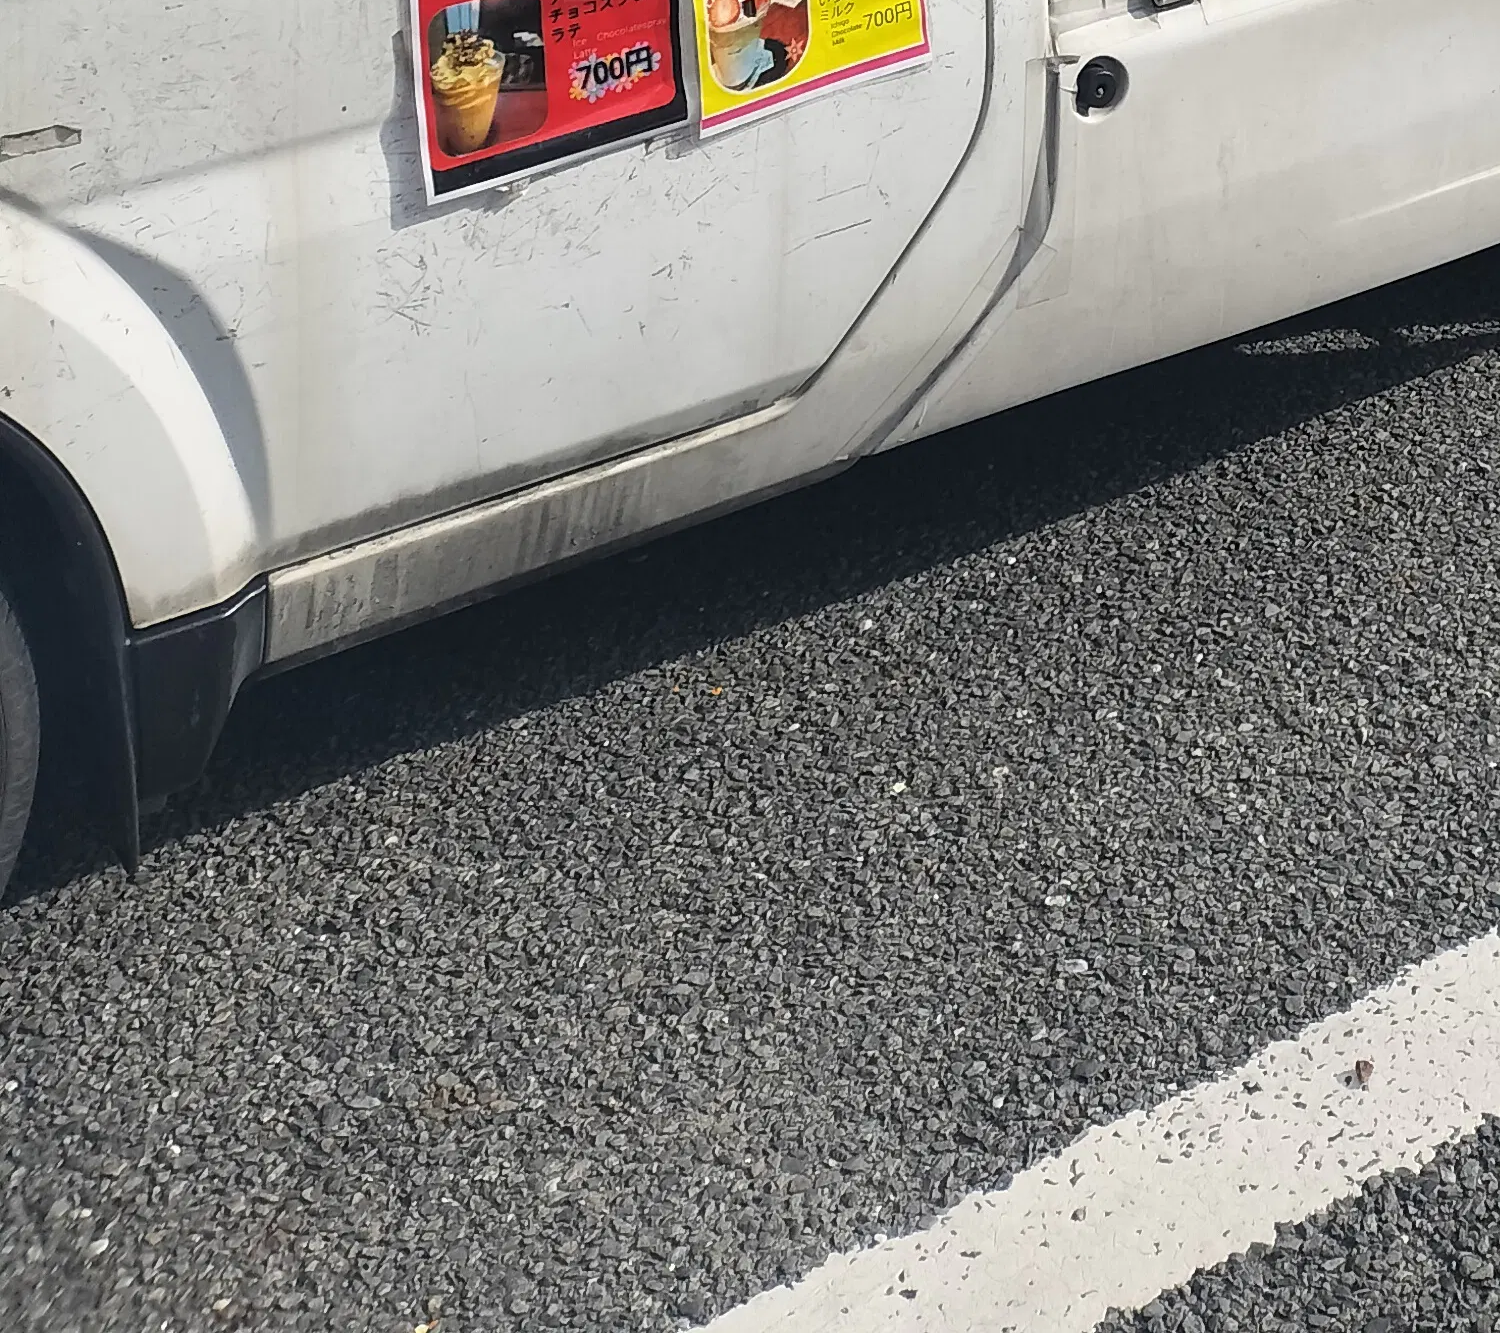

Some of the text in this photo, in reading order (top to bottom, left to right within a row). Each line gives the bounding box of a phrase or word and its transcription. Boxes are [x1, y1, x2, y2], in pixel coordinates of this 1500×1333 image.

[820, 2, 855, 21] ミルク
[863, 0, 912, 31] 700円
[551, 24, 581, 44] ラテ
[576, 45, 651, 90] 700円
